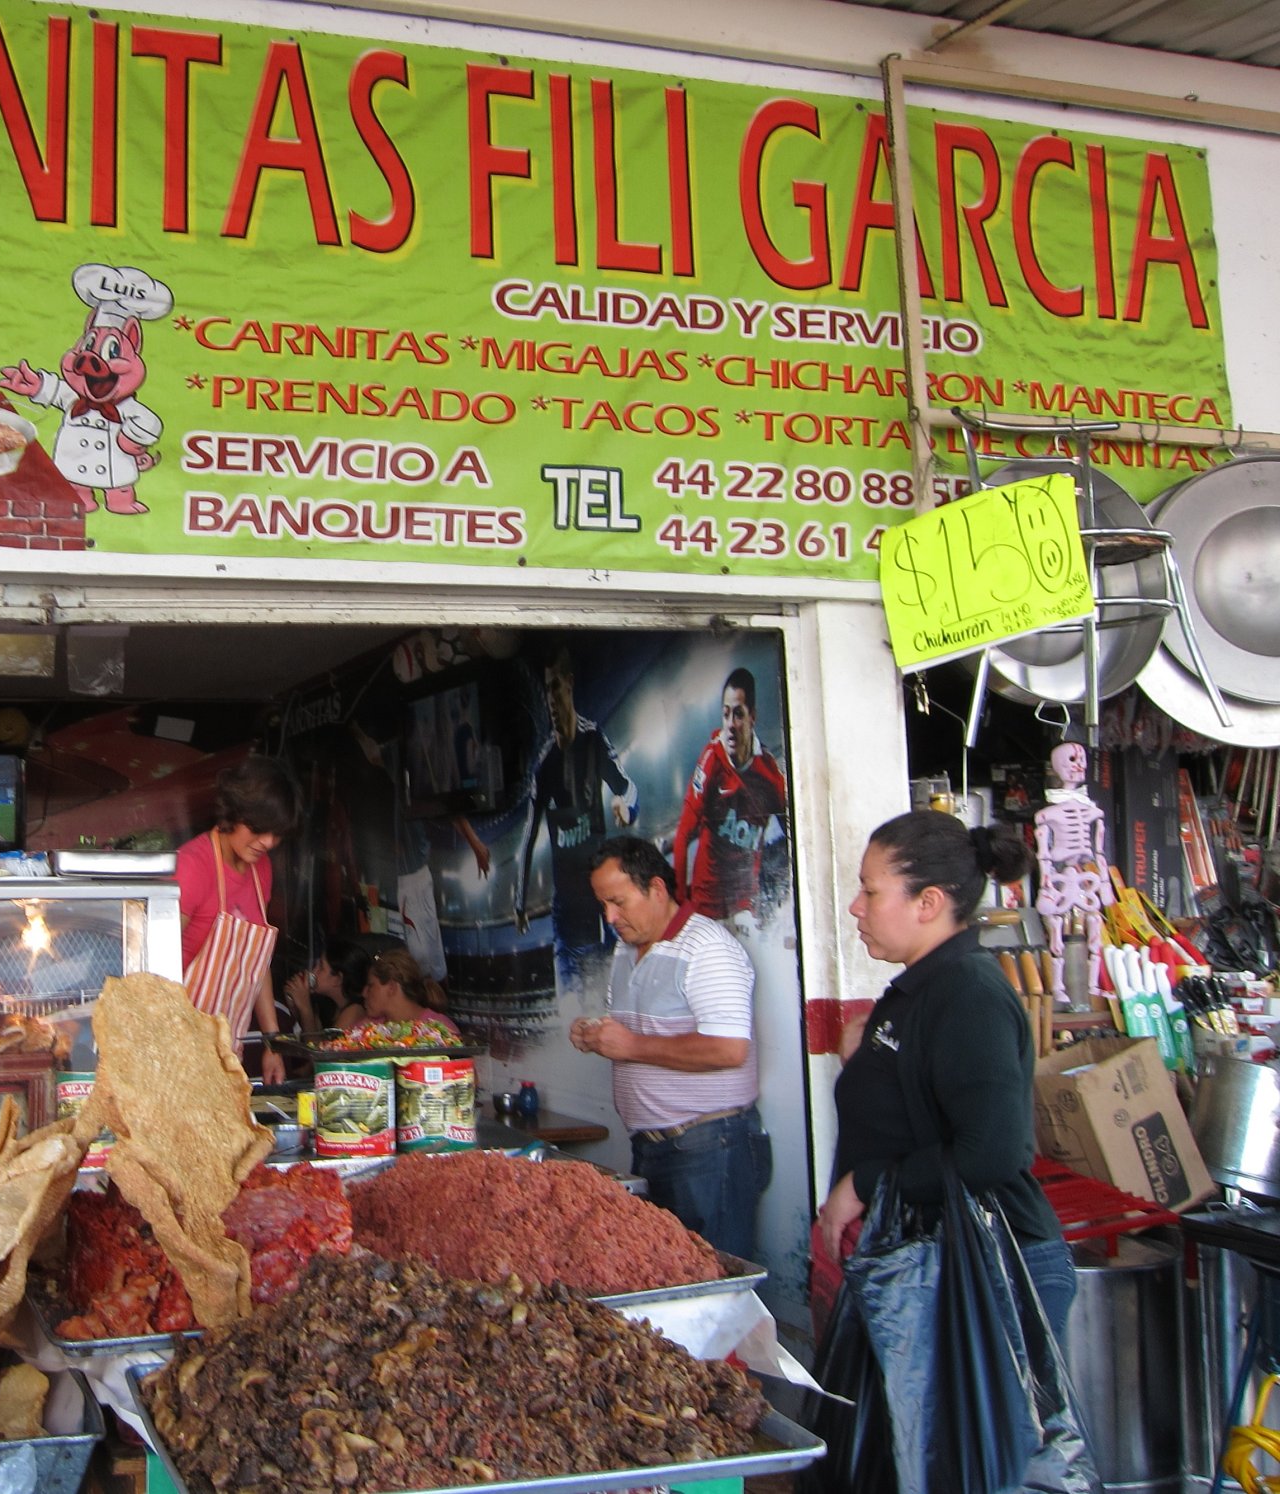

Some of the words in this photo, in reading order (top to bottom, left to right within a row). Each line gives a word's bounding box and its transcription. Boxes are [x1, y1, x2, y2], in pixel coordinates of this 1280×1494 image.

[466, 62, 694, 277] FILI
[741, 97, 1210, 329] GARCIA
[99, 275, 146, 301] Luis
[495, 282, 724, 330] CALIDAD
[734, 302, 765, 335] Y
[185, 434, 435, 483] SERVICIO
[445, 449, 488, 485] A
[657, 461, 715, 498] 44
[727, 465, 784, 499] 22
[795, 469, 851, 502] 80
[863, 471, 913, 505] 88
[188, 496, 524, 546] BANQUETES
[541, 464, 641, 532] TEL
[659, 518, 717, 553] 44
[729, 521, 786, 556] 23
[798, 524, 848, 558] 61
[1134, 820, 1147, 885] TRUPER
[1134, 1125, 1170, 1204] CILINDRO
